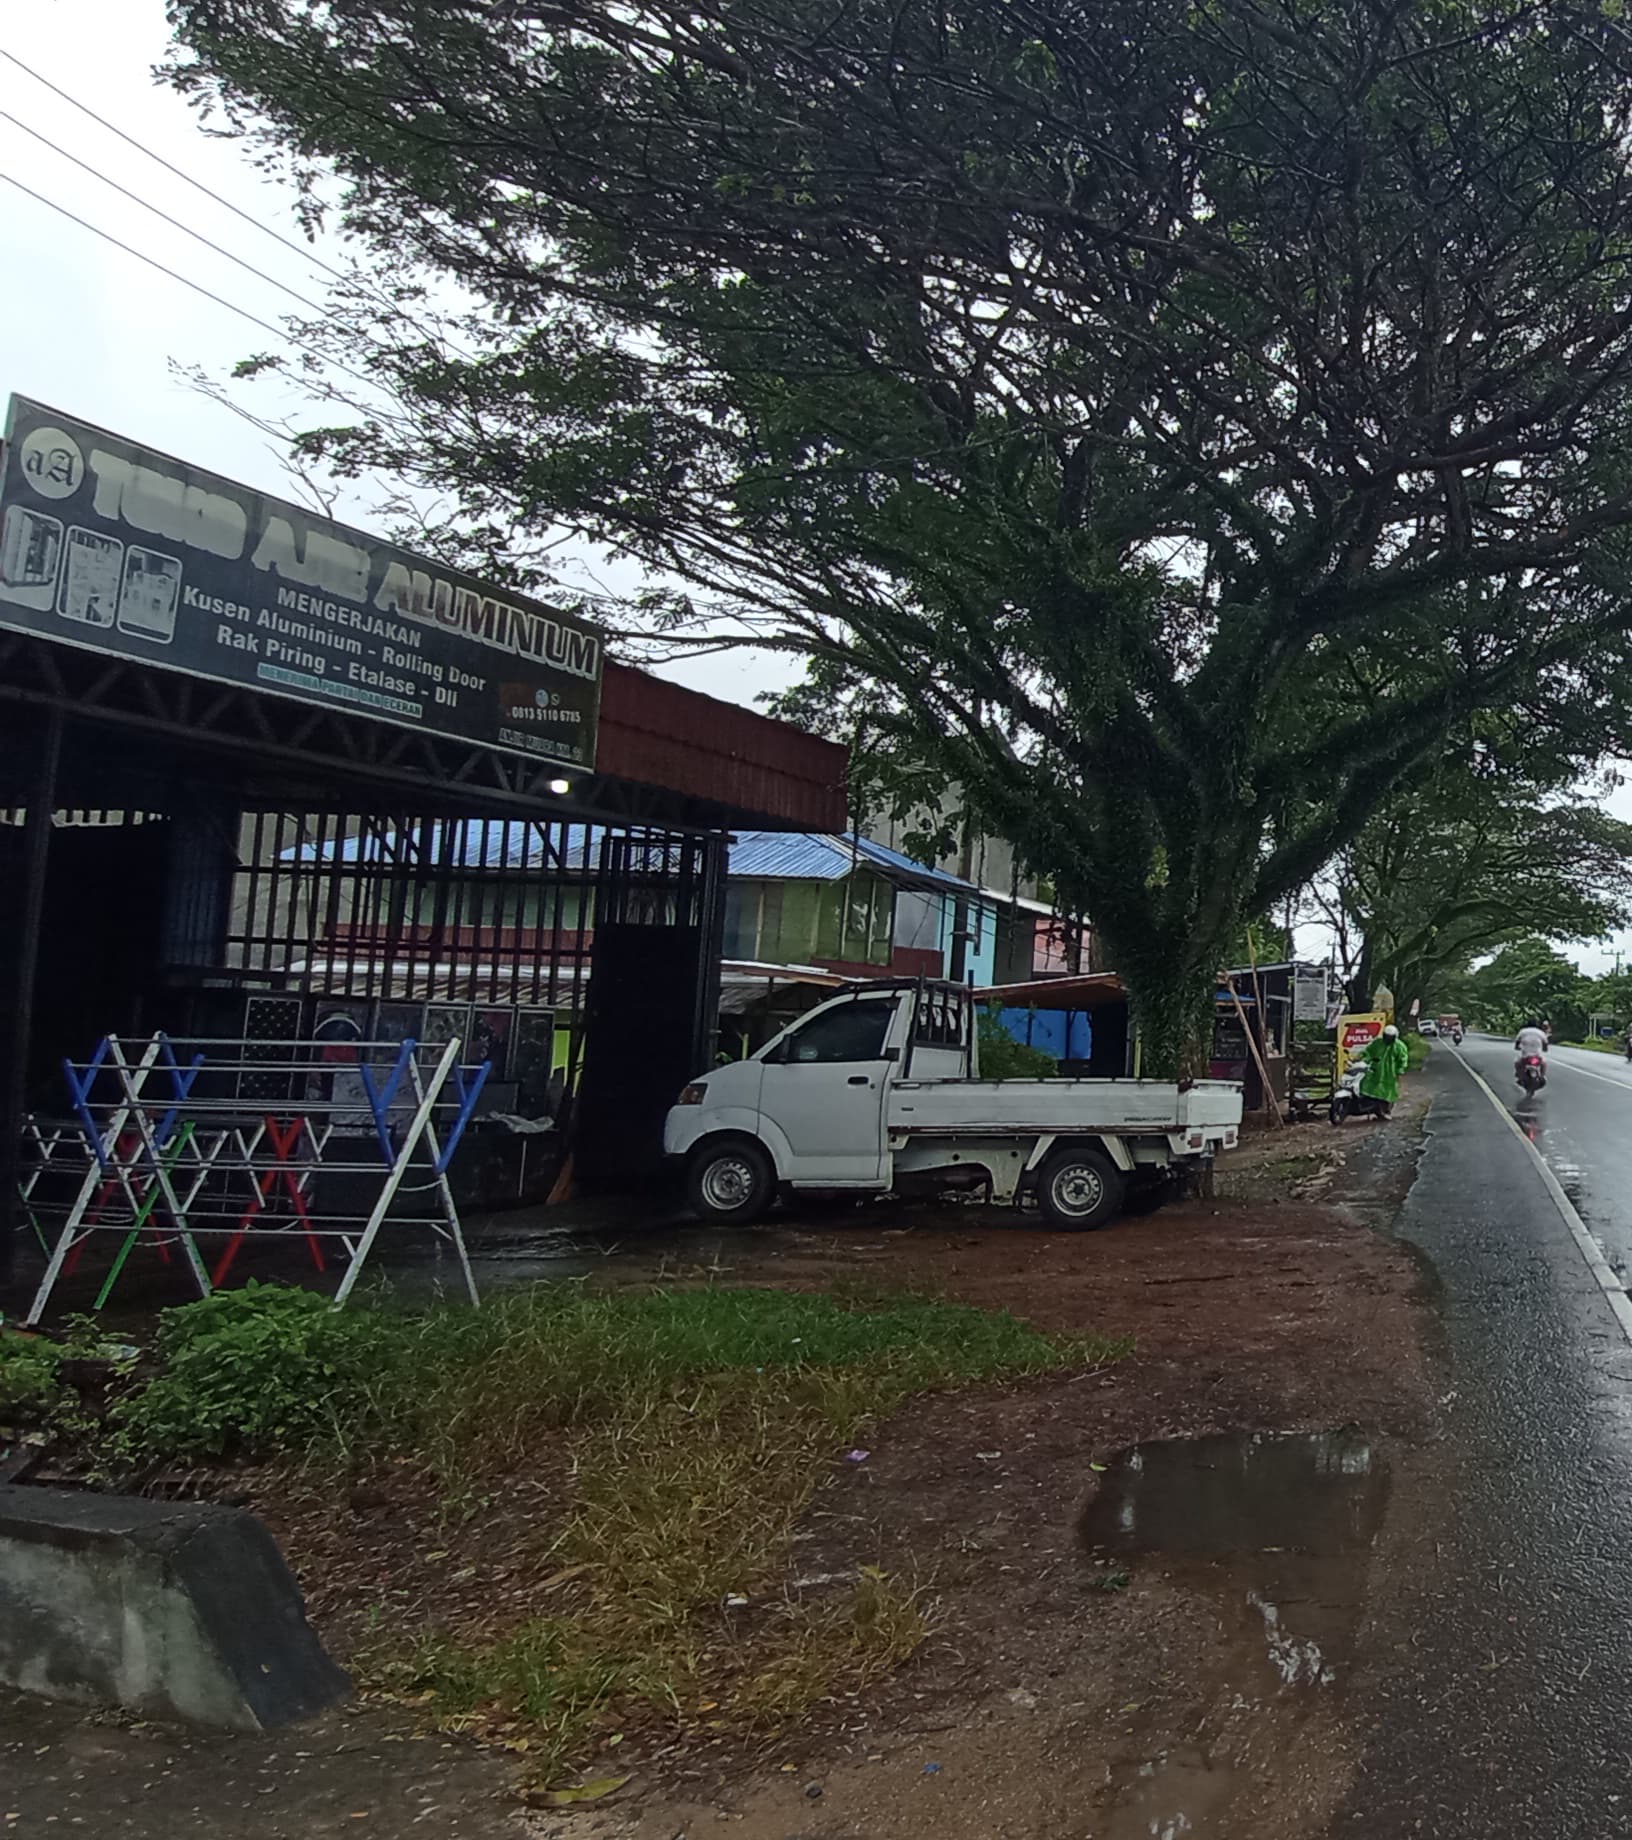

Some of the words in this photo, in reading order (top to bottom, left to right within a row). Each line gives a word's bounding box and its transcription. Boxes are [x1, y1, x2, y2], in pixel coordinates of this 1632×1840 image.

[183, 584, 250, 622] Kusen
[256, 608, 362, 656] Aluminium
[382, 645, 444, 683] Rolling
[449, 664, 487, 692] Door
[216, 623, 259, 654] Rak
[265, 638, 326, 675] Piring
[348, 661, 416, 696] Etalase
[277, 587, 422, 648] MENGERJAKAN
[373, 561, 600, 681] ALUMINIUM
